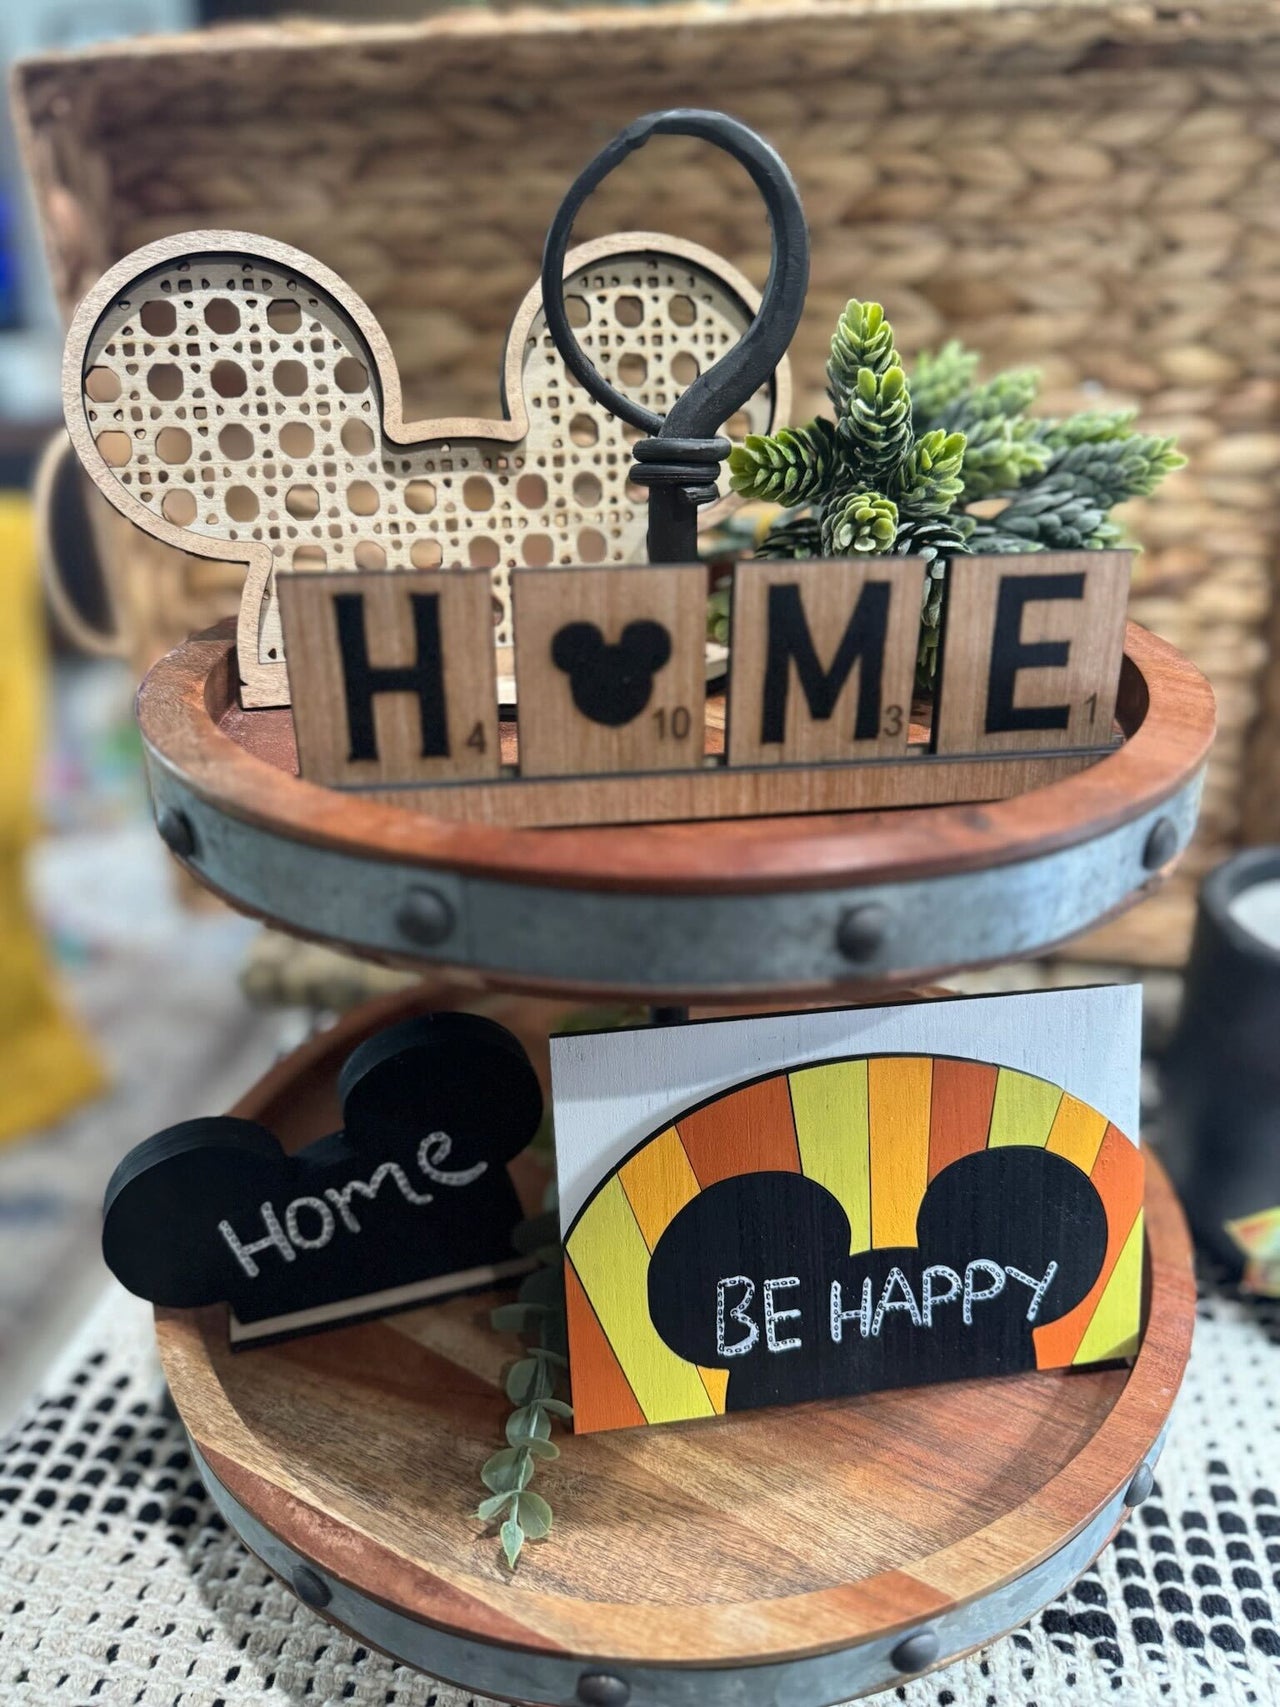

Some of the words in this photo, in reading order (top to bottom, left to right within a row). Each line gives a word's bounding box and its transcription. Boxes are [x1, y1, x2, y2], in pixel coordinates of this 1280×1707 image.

[465, 721, 487, 754] 4
[652, 706, 692, 741] 10
[882, 704, 904, 737] 3
[1083, 693, 1098, 725] 1
[715, 1275, 802, 1358] BE
[829, 1258, 1059, 1343] HAPPY
